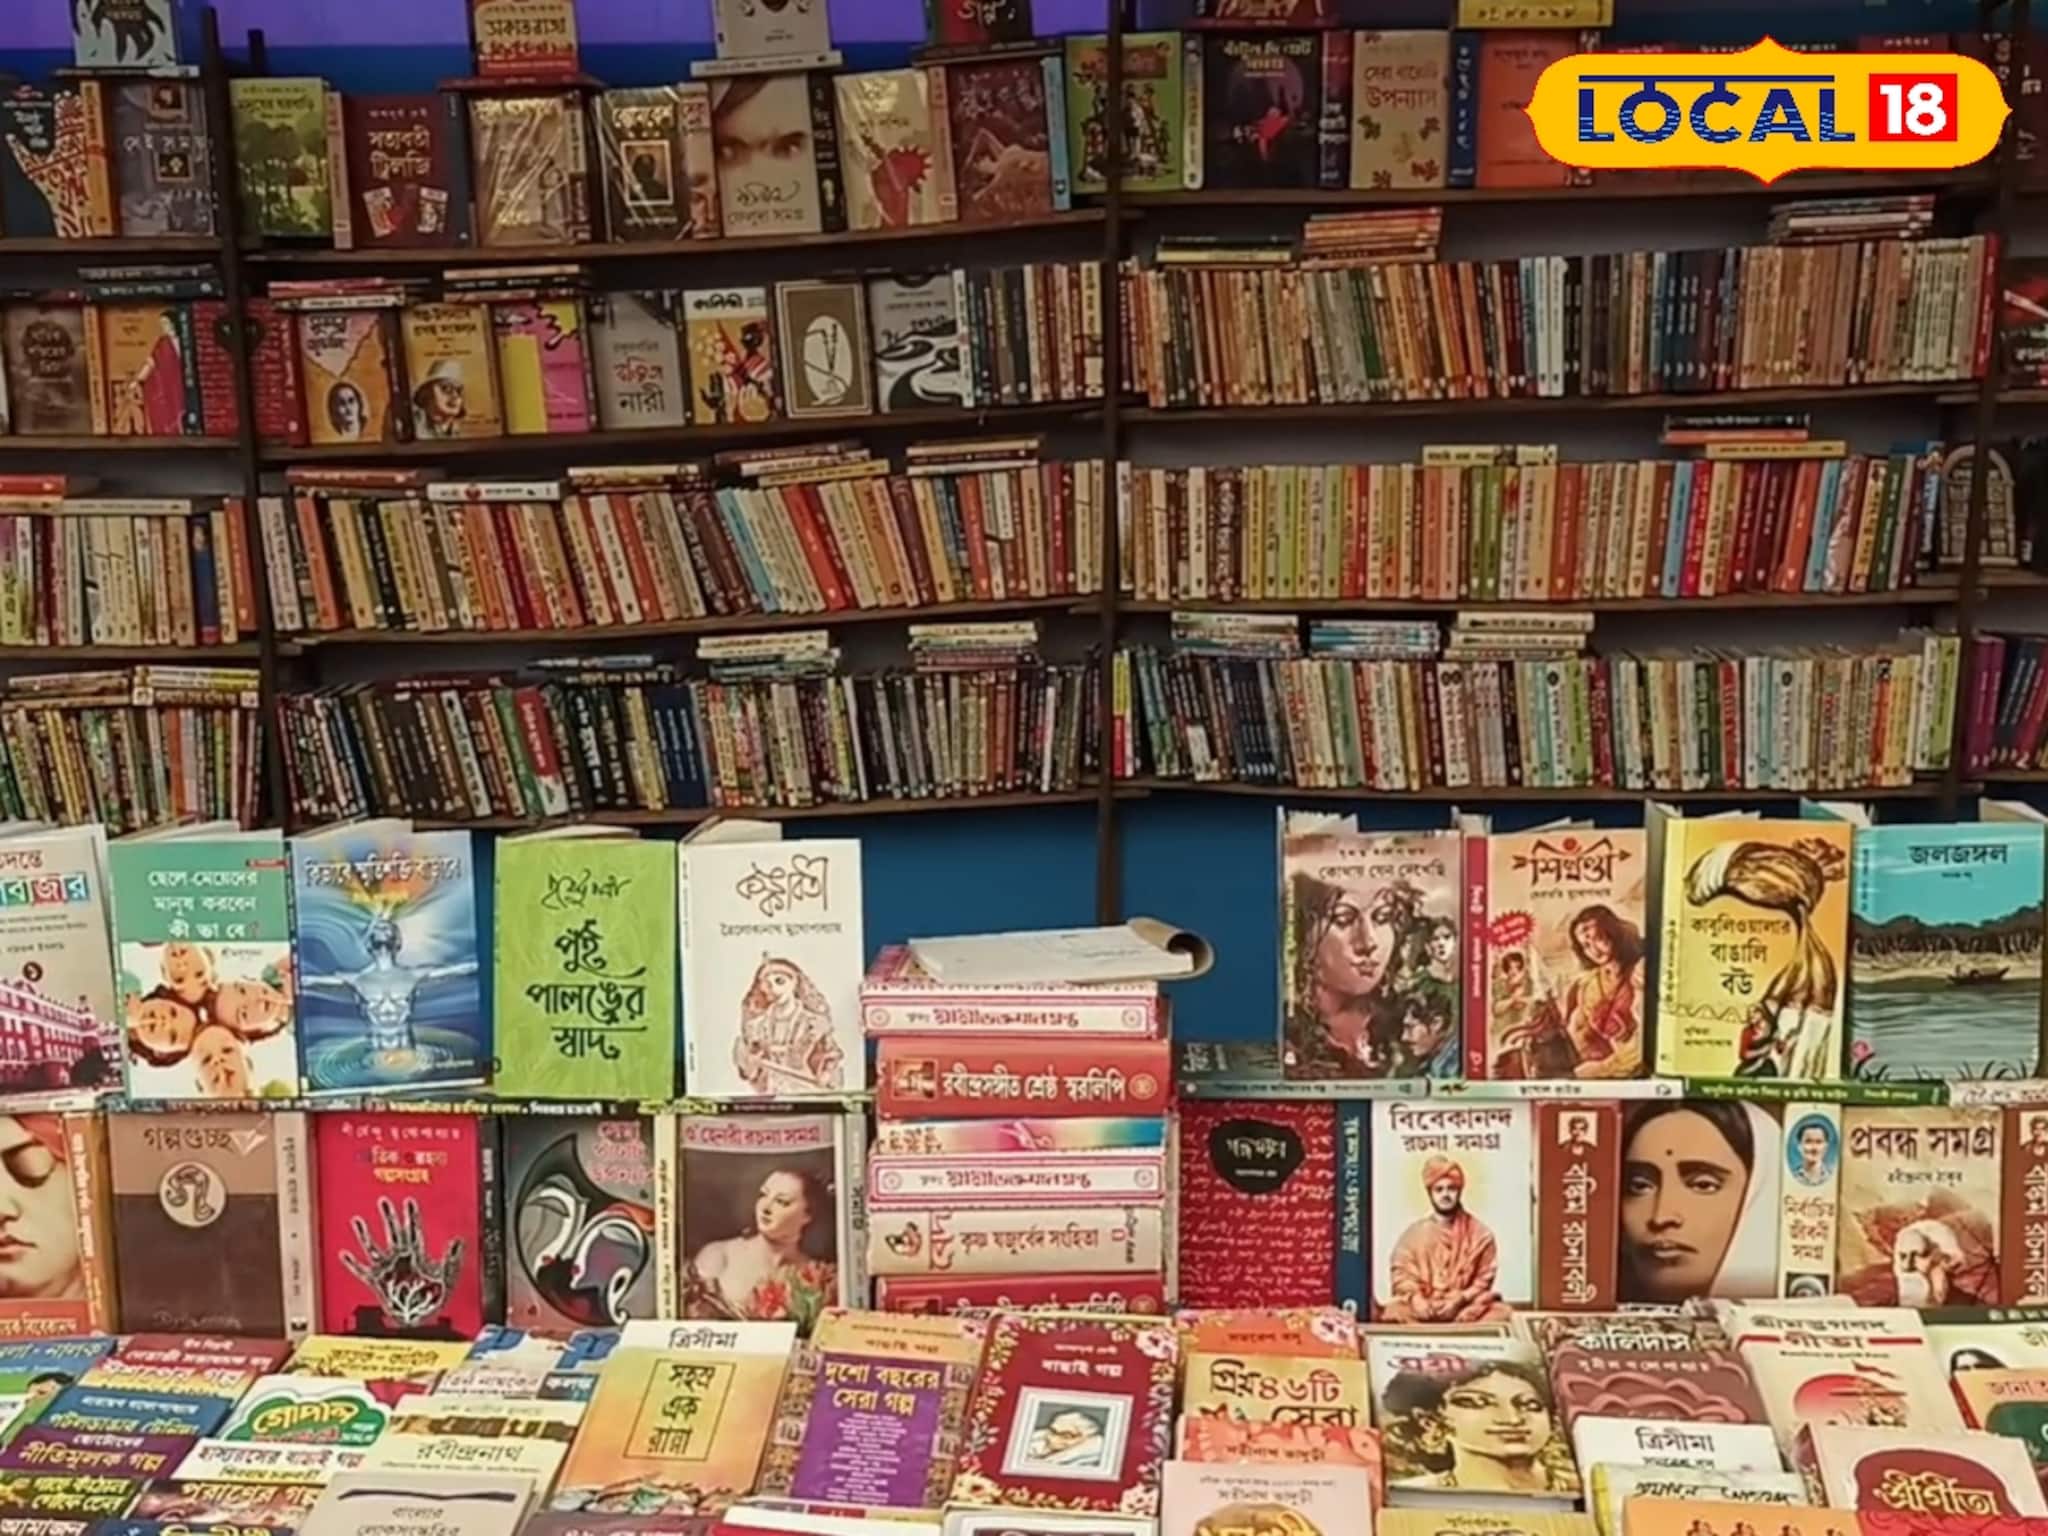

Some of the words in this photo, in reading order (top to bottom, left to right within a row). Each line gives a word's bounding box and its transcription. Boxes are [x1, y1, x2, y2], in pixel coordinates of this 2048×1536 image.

[617, 382, 665, 412] নারী
[1531, 838, 1616, 886] শিখণ্ডী
[1908, 844, 2009, 867] জলজঙ্গল
[152, 895, 194, 916] মানুষ
[202, 894, 256, 912] করবেন
[1690, 917, 1791, 938] কাবুলিওয়ালার
[1710, 941, 1768, 965] বাঙালি
[1721, 968, 1753, 996] বউ
[551, 1026, 648, 1060] স্বাদ
[1025, 1065, 1059, 1099] শ্রেষ্ঠ
[1063, 1067, 1126, 1103] স্বরলিপি
[1389, 1102, 1513, 1131] বিবেকানন্দ
[783, 1125, 820, 1143] সমগ্র
[1402, 1133, 1449, 1152] রচনা
[1456, 1133, 1502, 1151] সমগ্র
[1850, 1125, 1919, 1161] প্রবন্ধ
[1927, 1125, 1996, 1161] সমগ্র
[1562, 1162, 1598, 1214] বঙ্কিম
[1934, 1168, 1964, 1187] ঠাকুর
[960, 1229, 988, 1254] কৃষ্ণ
[1047, 1222, 1100, 1250] সংহিতা
[1562, 1220, 1598, 1304] রচনাবলী
[668, 1328, 738, 1349] ত্রিসীমা
[1784, 1330, 1867, 1349] গীতা
[669, 1364, 716, 1392] সহস্র
[824, 1361, 869, 1385] দুশো
[874, 1364, 941, 1390] বছরের
[1208, 1358, 1260, 1398] প্রিয়
[661, 1396, 702, 1421] এক
[832, 1389, 878, 1408] সেরা
[884, 1391, 916, 1415] গল্প
[417, 1440, 525, 1463] রবীন্দ্রনাথ
[647, 1426, 693, 1456] রান্না
[1635, 1425, 1714, 1452] ত্রিসীমা
[18, 1442, 123, 1469] নীতিমূলক
[129, 1452, 167, 1472] গল্প
